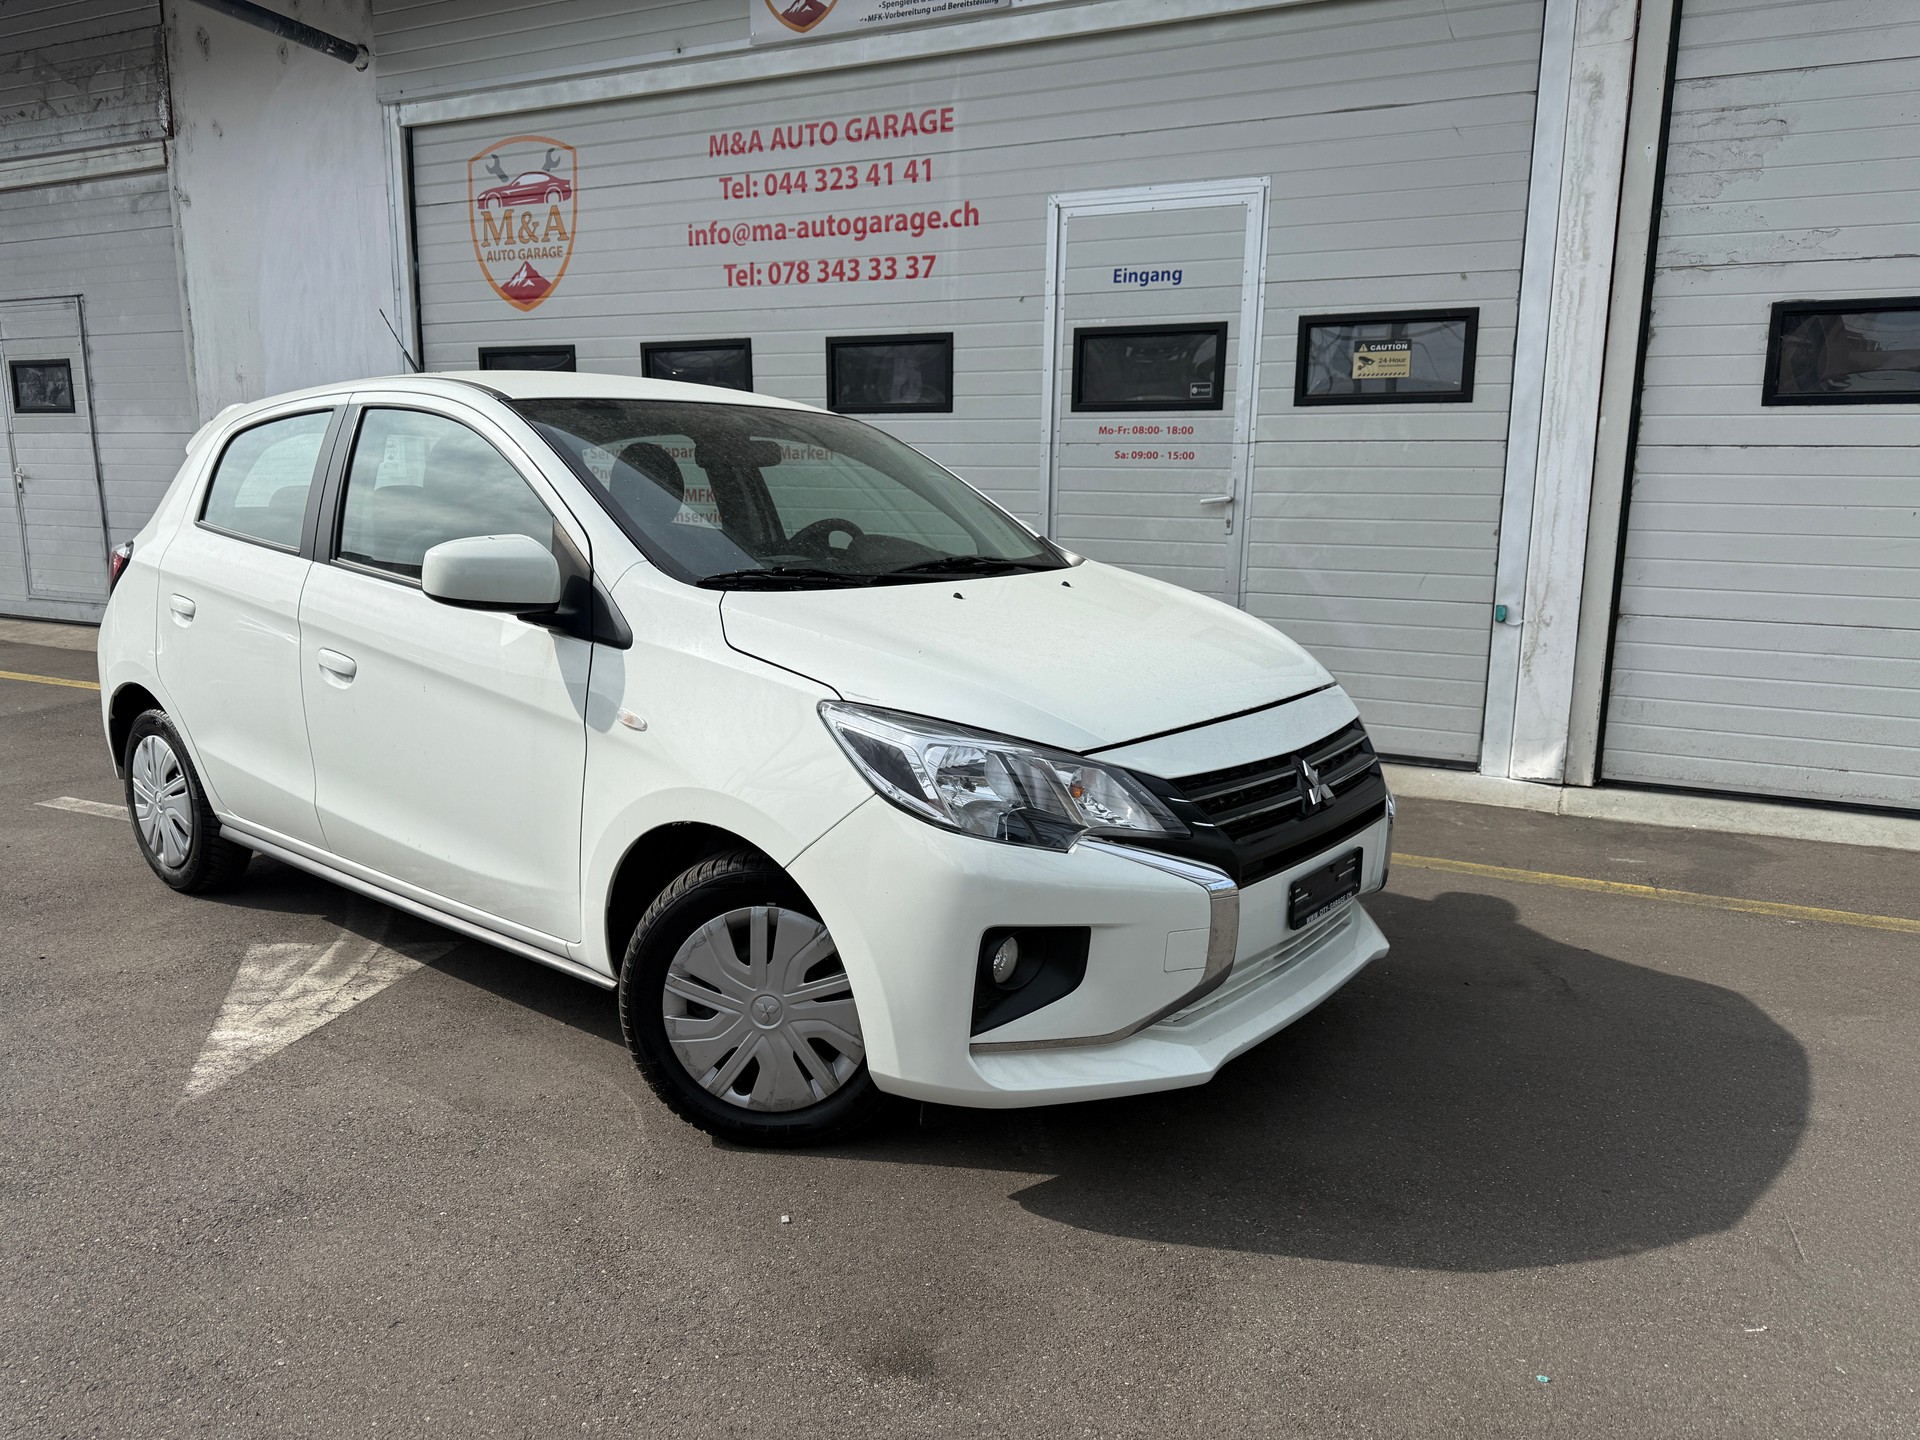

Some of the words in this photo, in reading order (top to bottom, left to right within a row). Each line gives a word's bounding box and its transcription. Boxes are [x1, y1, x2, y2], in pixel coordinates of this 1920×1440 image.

[932, 3, 947, 12] und
[709, 130, 763, 158] M&A
[770, 121, 838, 151] AUTO
[845, 107, 954, 143] GARAGE
[719, 174, 758, 200] Tel:
[764, 171, 808, 196] 044
[815, 165, 858, 192] 323
[866, 162, 893, 187] 41
[904, 158, 932, 183] 41
[480, 204, 570, 248] M&A
[687, 201, 979, 246] info@ma-autogarage.ch
[486, 249, 515, 263] AUTO
[518, 246, 563, 260] GARAGE
[723, 262, 762, 287] Tel:
[767, 260, 810, 285] 078
[817, 258, 860, 283] 343
[868, 256, 897, 281] 33
[905, 255, 936, 279] 37
[1113, 268, 1183, 286] Eingang
[1370, 343, 1408, 351] CAUTION
[1098, 426, 1130, 435] Mo-Fr:
[1166, 426, 1194, 435] 18:00
[1114, 450, 1129, 459] Sa:
[1131, 451, 1159, 460] 09:00
[1168, 451, 1195, 460] 15:00
